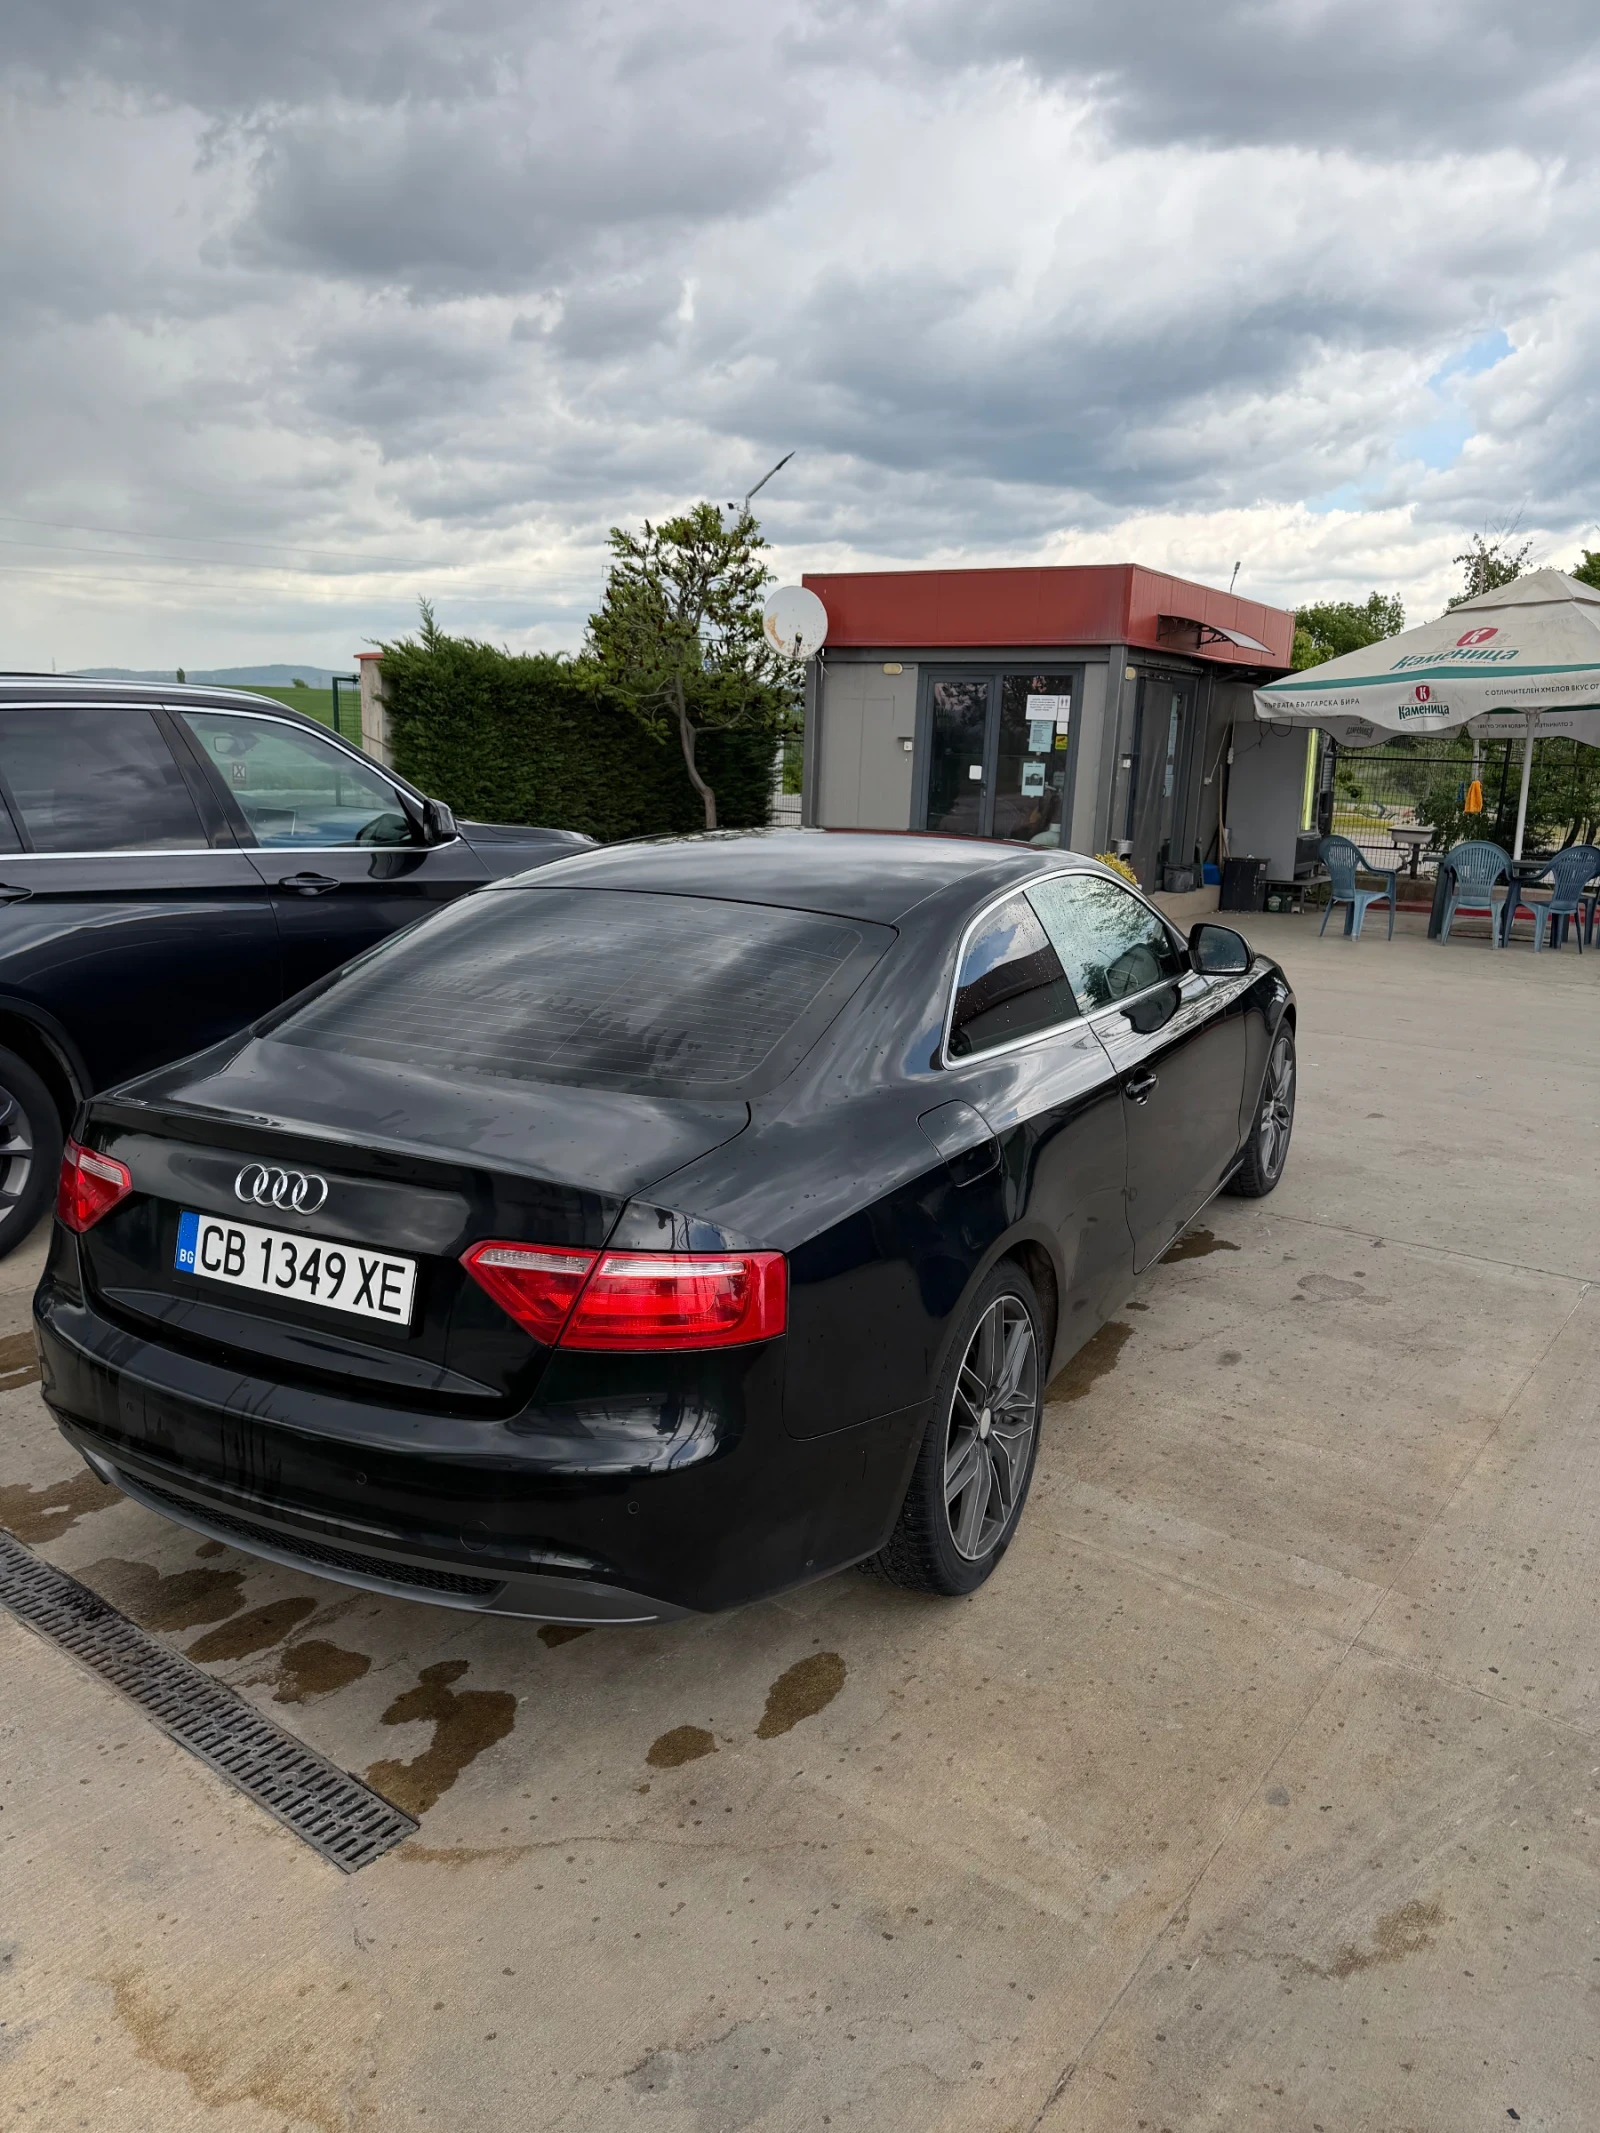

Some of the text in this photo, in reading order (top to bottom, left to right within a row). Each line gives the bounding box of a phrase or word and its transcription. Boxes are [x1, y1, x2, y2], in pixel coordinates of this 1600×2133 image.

[1389, 648, 1520, 671] Каменица
[1490, 687, 1540, 696] ОТЛИЧИТЕЛЕН
[1540, 685, 1570, 693] ХМЕЛОВ
[1571, 683, 1589, 692] ВКУС
[1295, 699, 1339, 708] БЪЛГАРСКА
[1340, 698, 1360, 706] БИРА
[1398, 703, 1450, 720] Каменица
[179, 1249, 195, 1265] BG
[201, 1225, 406, 1316] CB 1349 XE
